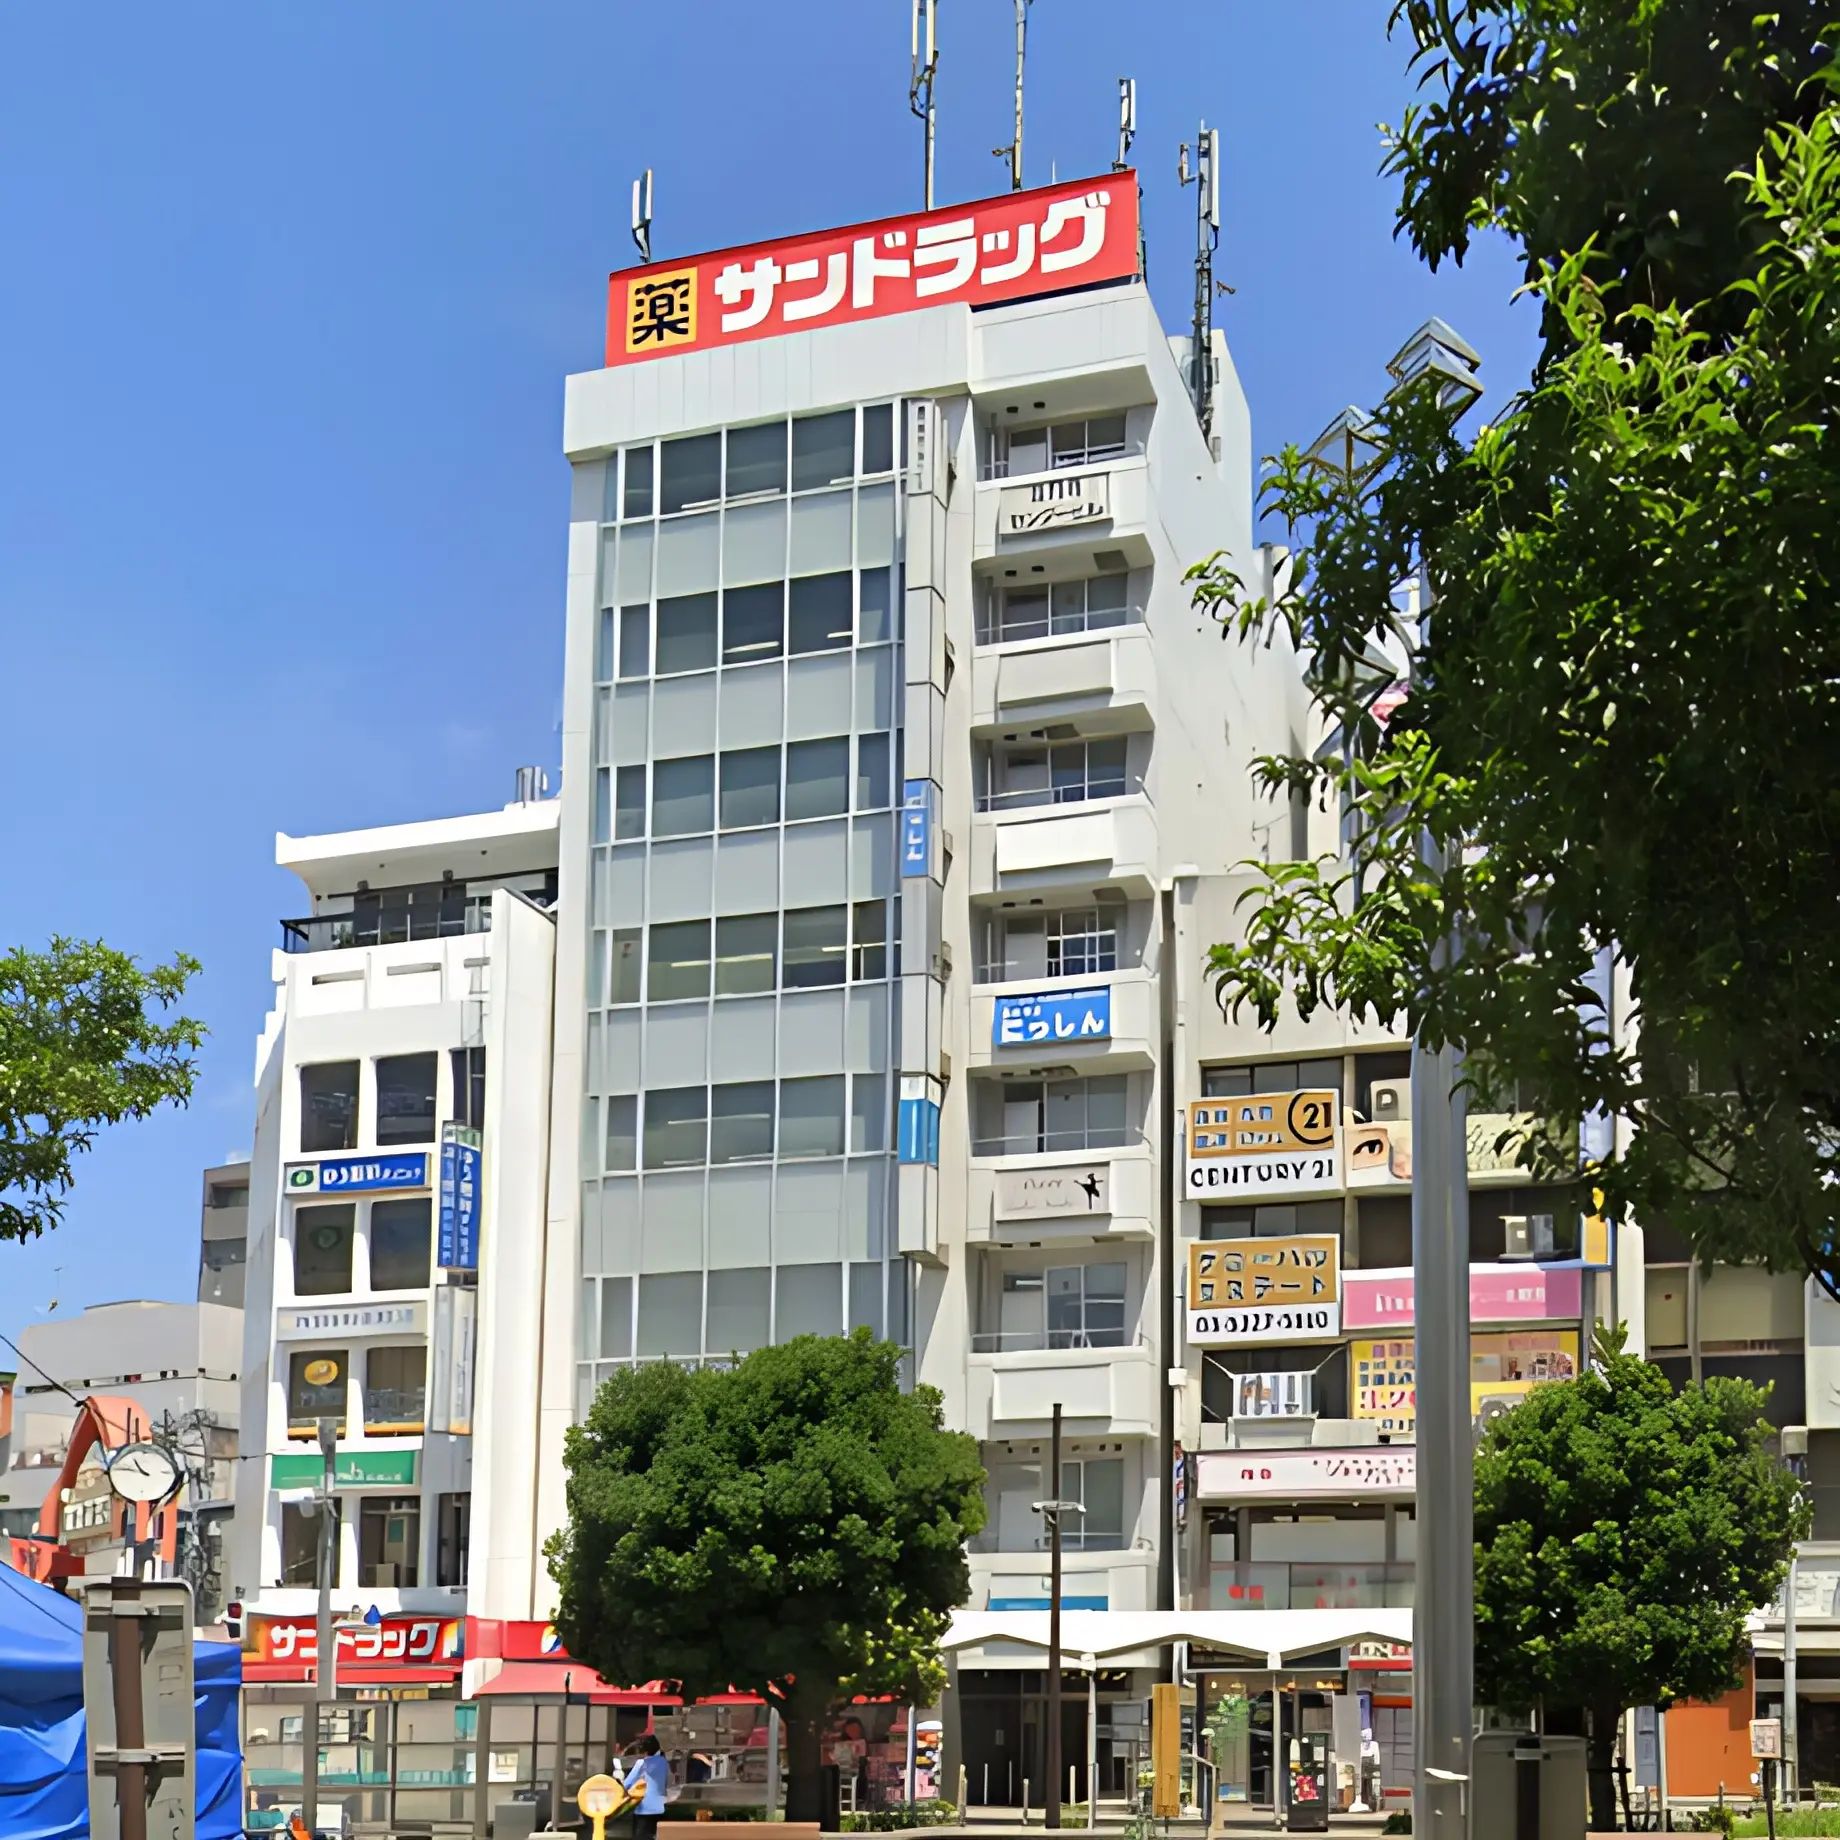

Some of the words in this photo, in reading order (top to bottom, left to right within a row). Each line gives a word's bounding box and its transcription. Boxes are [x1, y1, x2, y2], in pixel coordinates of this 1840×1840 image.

[633, 277, 691, 345] 薬
[714, 190, 1112, 333] サンドラッグ
